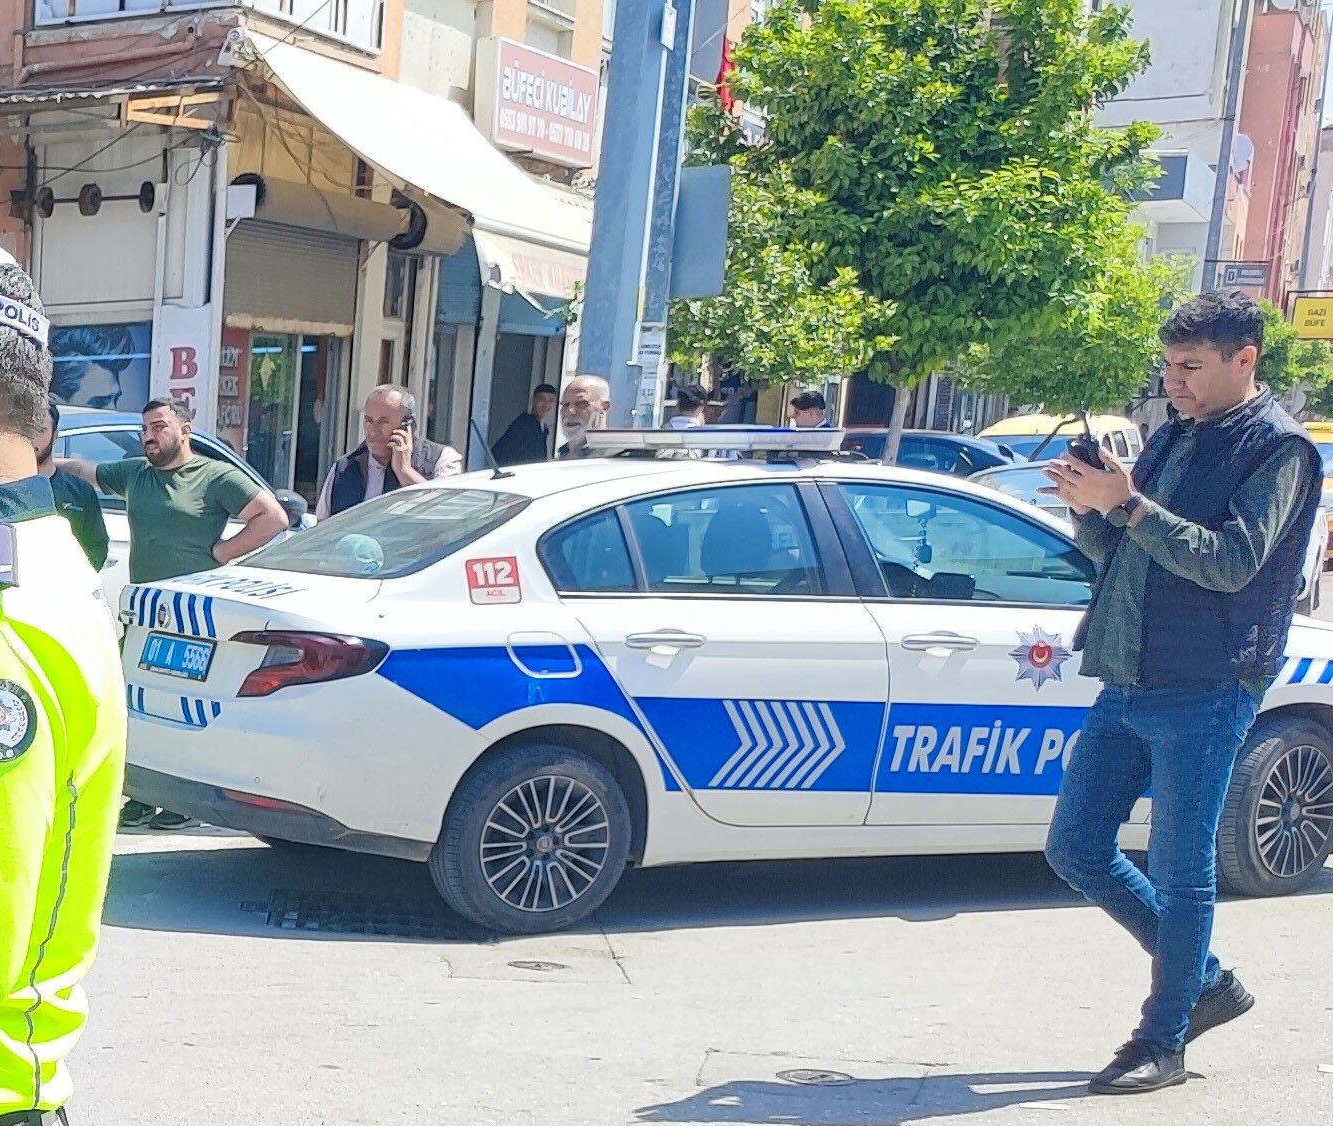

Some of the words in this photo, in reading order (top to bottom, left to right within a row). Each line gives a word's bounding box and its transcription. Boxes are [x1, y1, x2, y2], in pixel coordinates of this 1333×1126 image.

[472, 560, 515, 586] 112
[147, 638, 161, 661] 01
[165, 641, 176, 665] A
[890, 719, 1032, 774] TRAFİK
